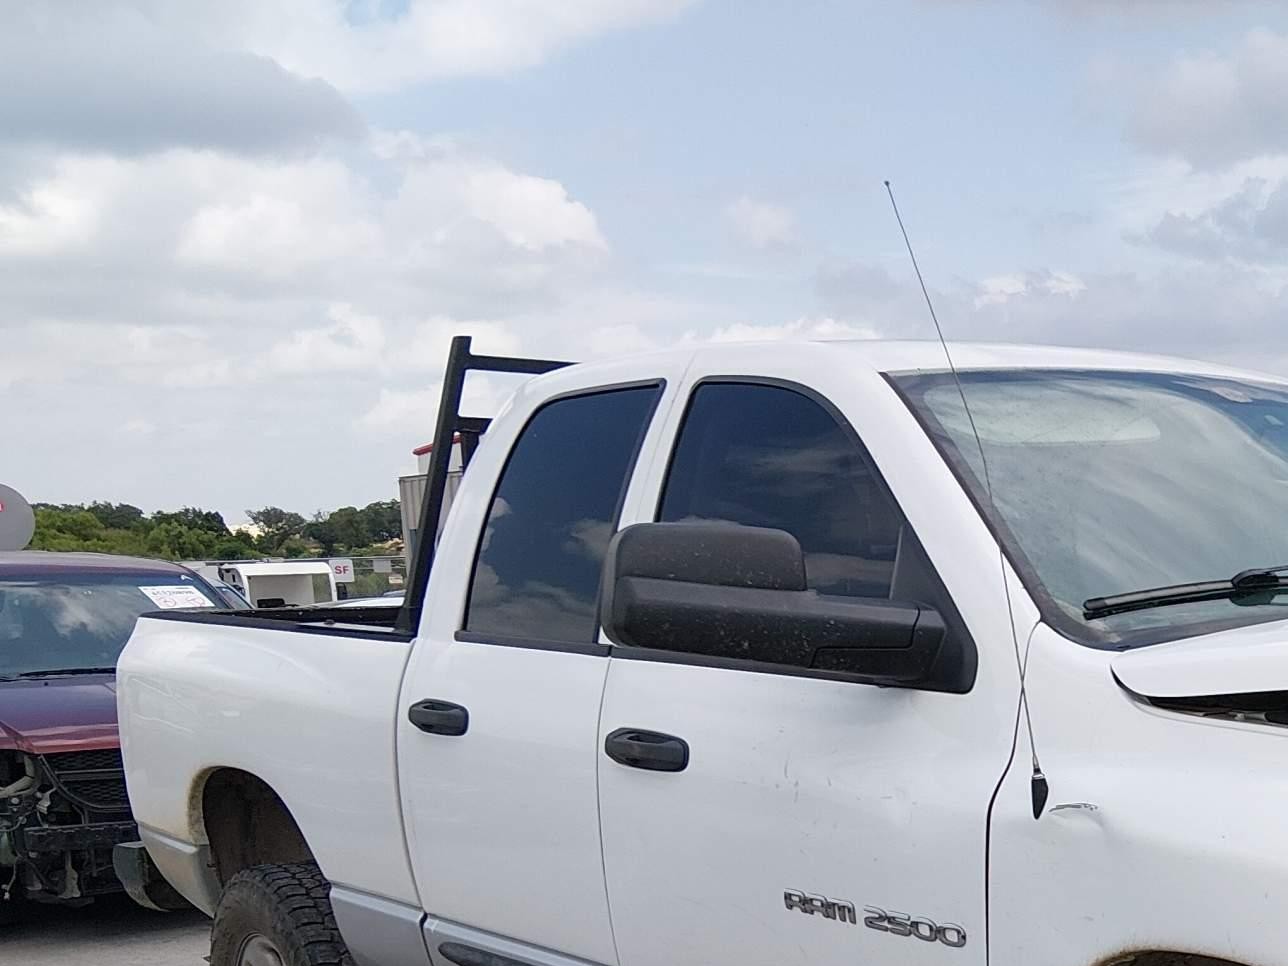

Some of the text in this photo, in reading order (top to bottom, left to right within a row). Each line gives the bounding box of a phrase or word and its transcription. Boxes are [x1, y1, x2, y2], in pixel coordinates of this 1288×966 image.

[334, 565, 349, 575] SF
[784, 888, 967, 948] RAM 2500
